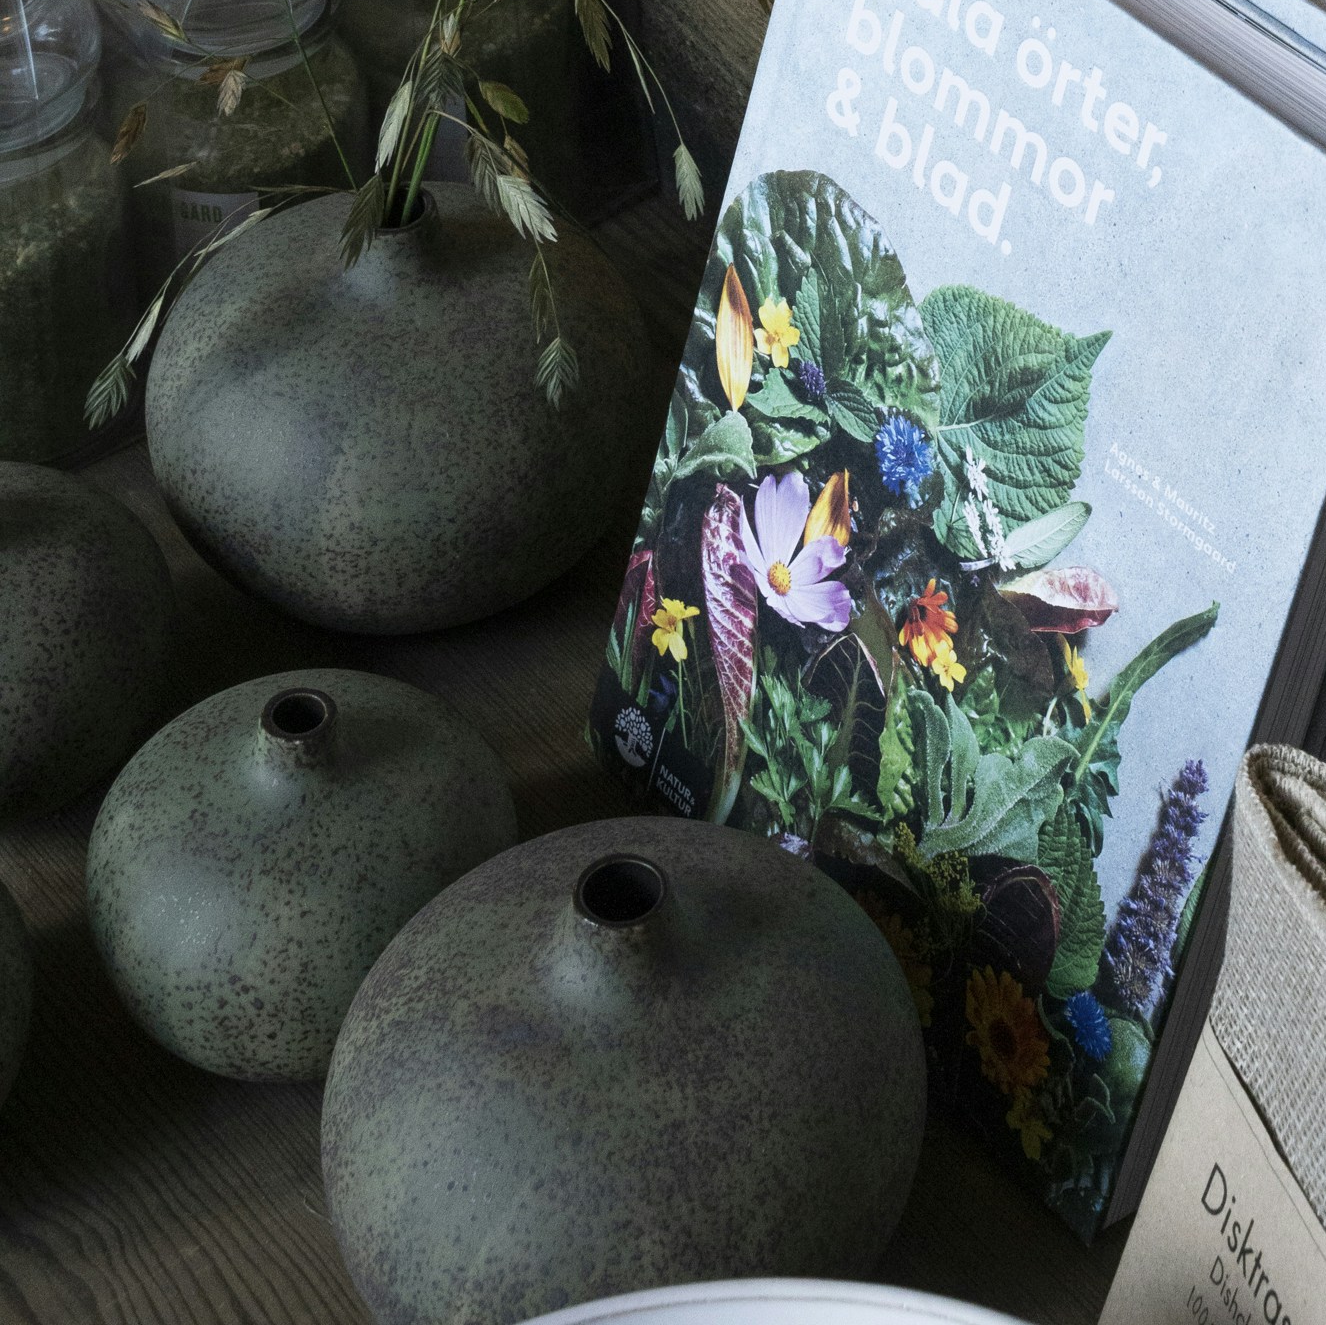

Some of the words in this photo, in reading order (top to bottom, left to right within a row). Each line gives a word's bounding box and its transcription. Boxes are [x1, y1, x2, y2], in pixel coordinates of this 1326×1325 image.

[1016, 16, 1169, 189] örter,
[825, 67, 864, 138] &
[875, 97, 1013, 256] blad.
[1105, 460, 1154, 508] Larsson
[1156, 502, 1237, 574] Stormgaard
[1109, 442, 1149, 480] Agnes
[1151, 475, 1161, 491] &
[1164, 485, 1217, 535] Mauritz
[656, 777, 691, 817] KULTUR
